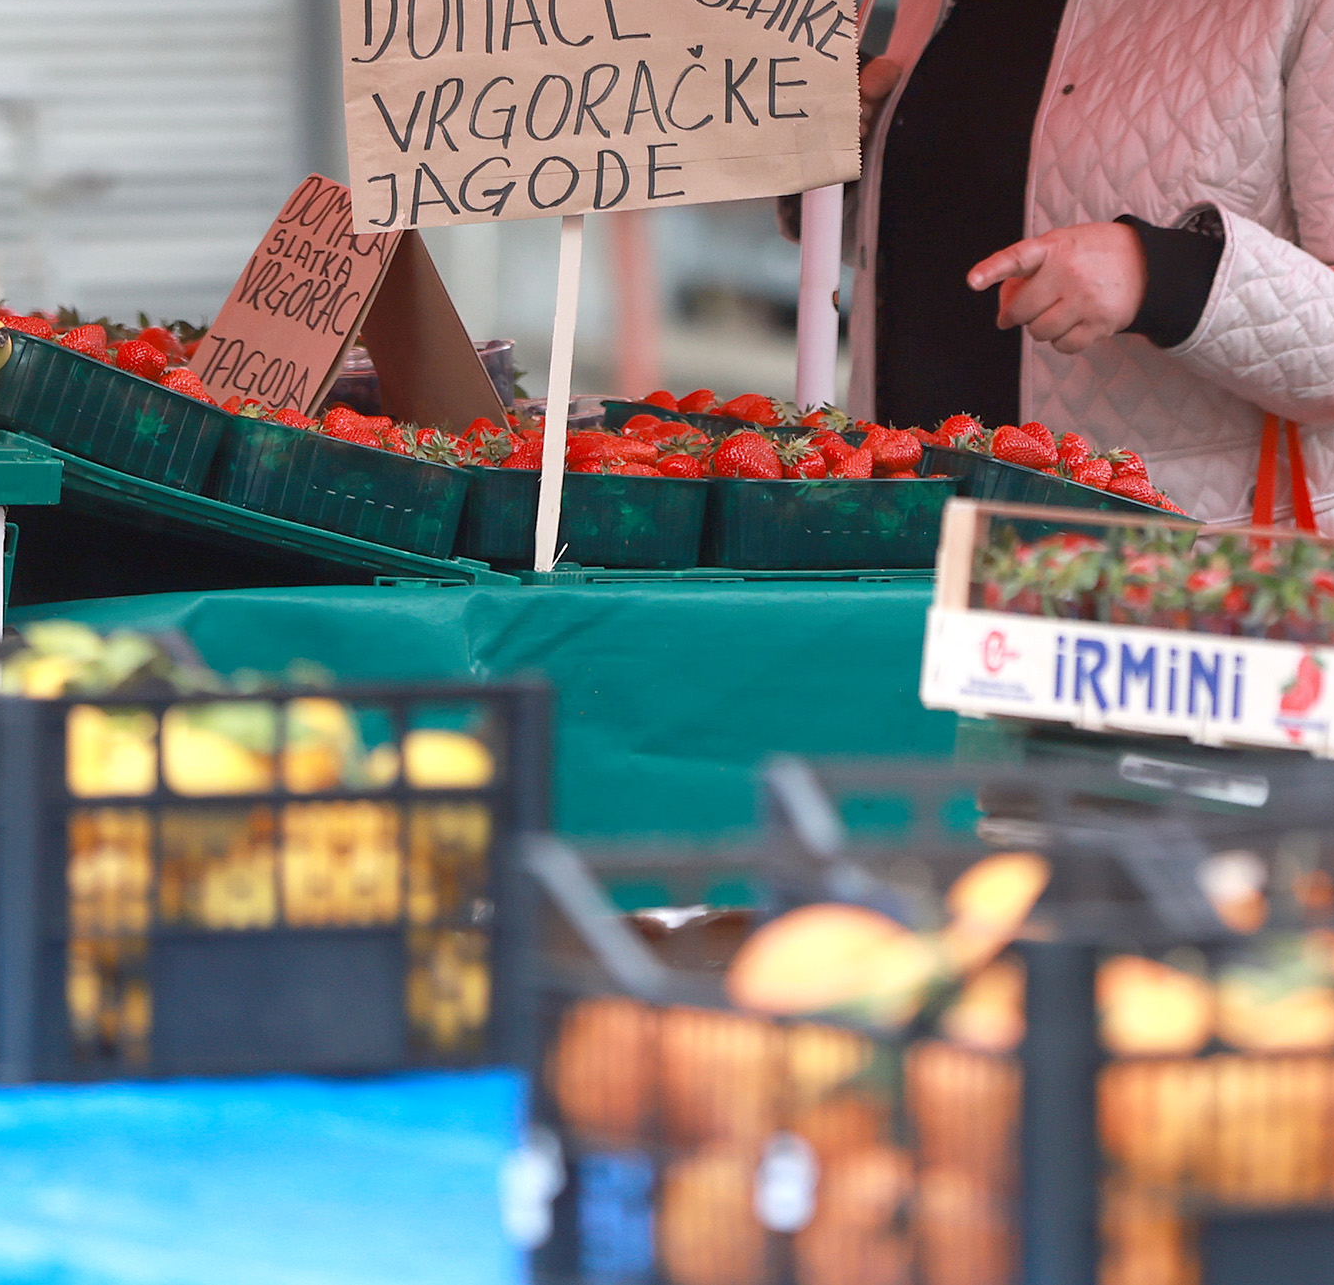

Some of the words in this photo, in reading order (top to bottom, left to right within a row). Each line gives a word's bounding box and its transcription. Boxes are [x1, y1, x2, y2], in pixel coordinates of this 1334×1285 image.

[372, 45, 809, 154] VRGORAČKE
[369, 143, 685, 228] JAGODE
[267, 229, 353, 287] SLATKA
[200, 334, 310, 411] JAGODA
